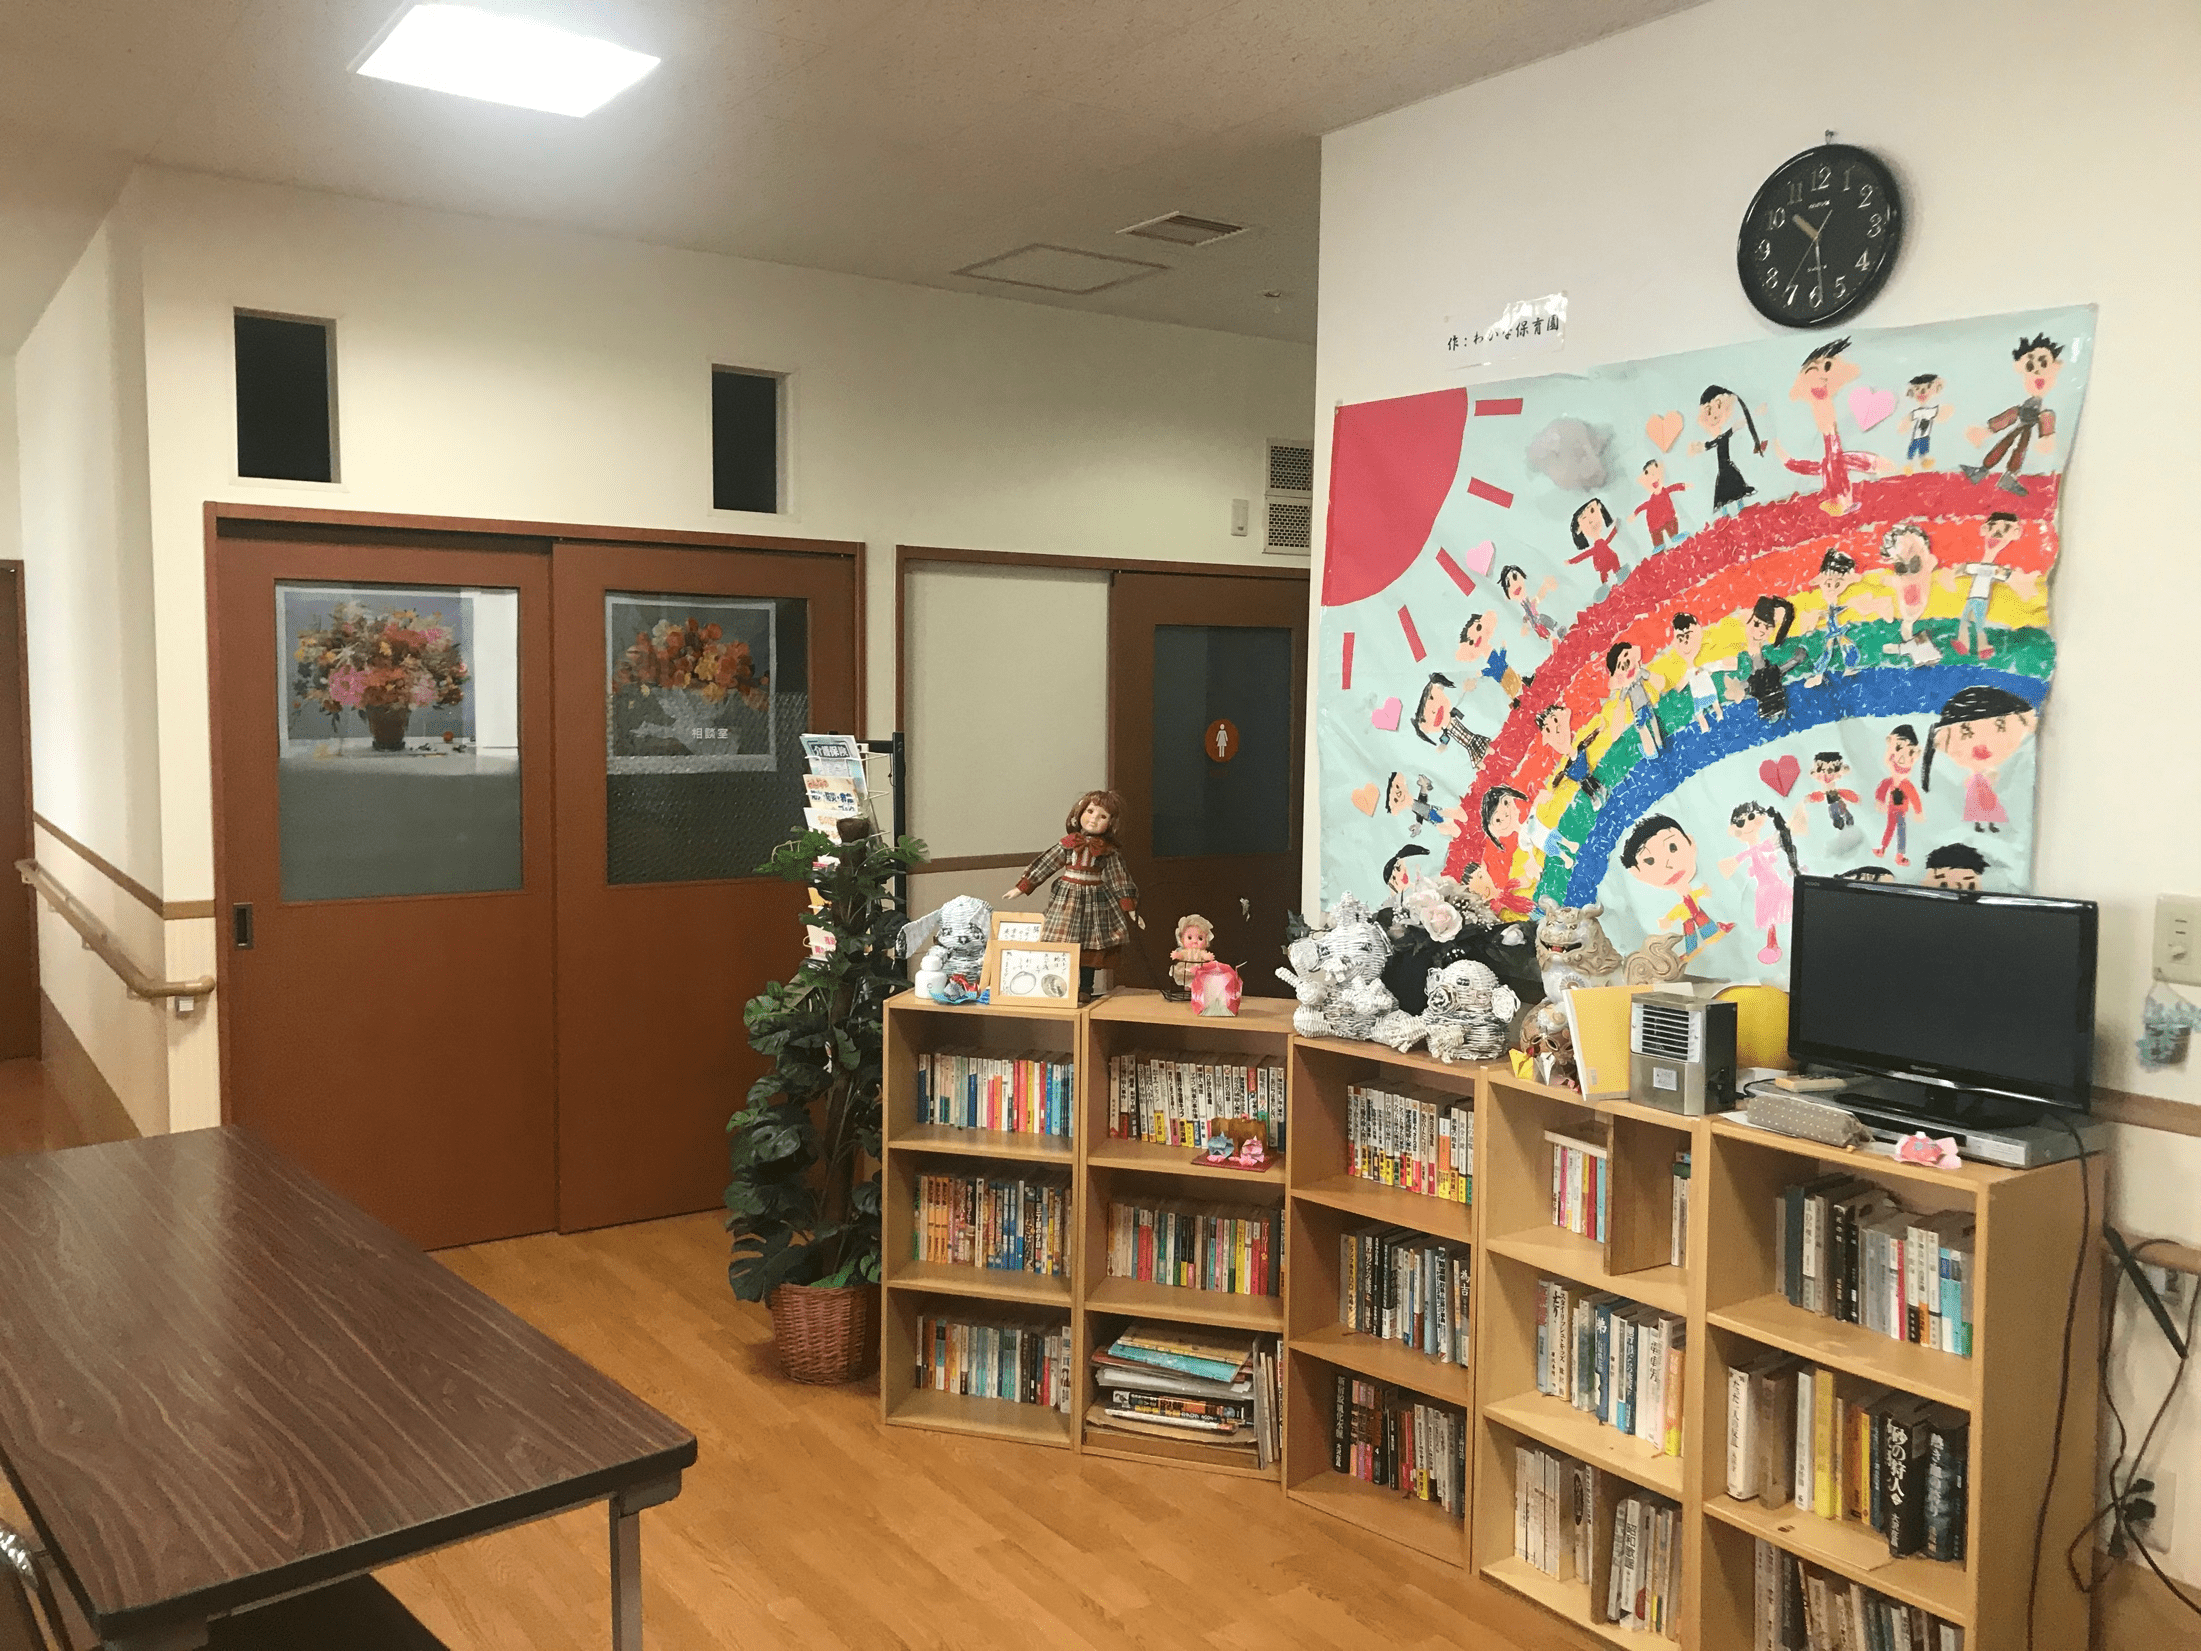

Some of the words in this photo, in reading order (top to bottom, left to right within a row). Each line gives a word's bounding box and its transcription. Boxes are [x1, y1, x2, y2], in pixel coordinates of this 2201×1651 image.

[1810, 166, 1832, 191] 12
[1842, 168, 1851, 192] 1
[1787, 181, 1803, 205] 11
[1858, 184, 1874, 209] 2
[1766, 207, 1786, 230] 10
[1867, 213, 1882, 238] 3
[1755, 239, 1771, 261] 9
[1855, 250, 1870, 271] 4
[1766, 267, 1779, 289] 8
[1833, 275, 1847, 299] 5
[1784, 284, 1799, 308] 7
[1809, 286, 1823, 309] 6
[691, 727, 729, 740] 相談室
[1596, 1317, 1607, 1335] 弟
